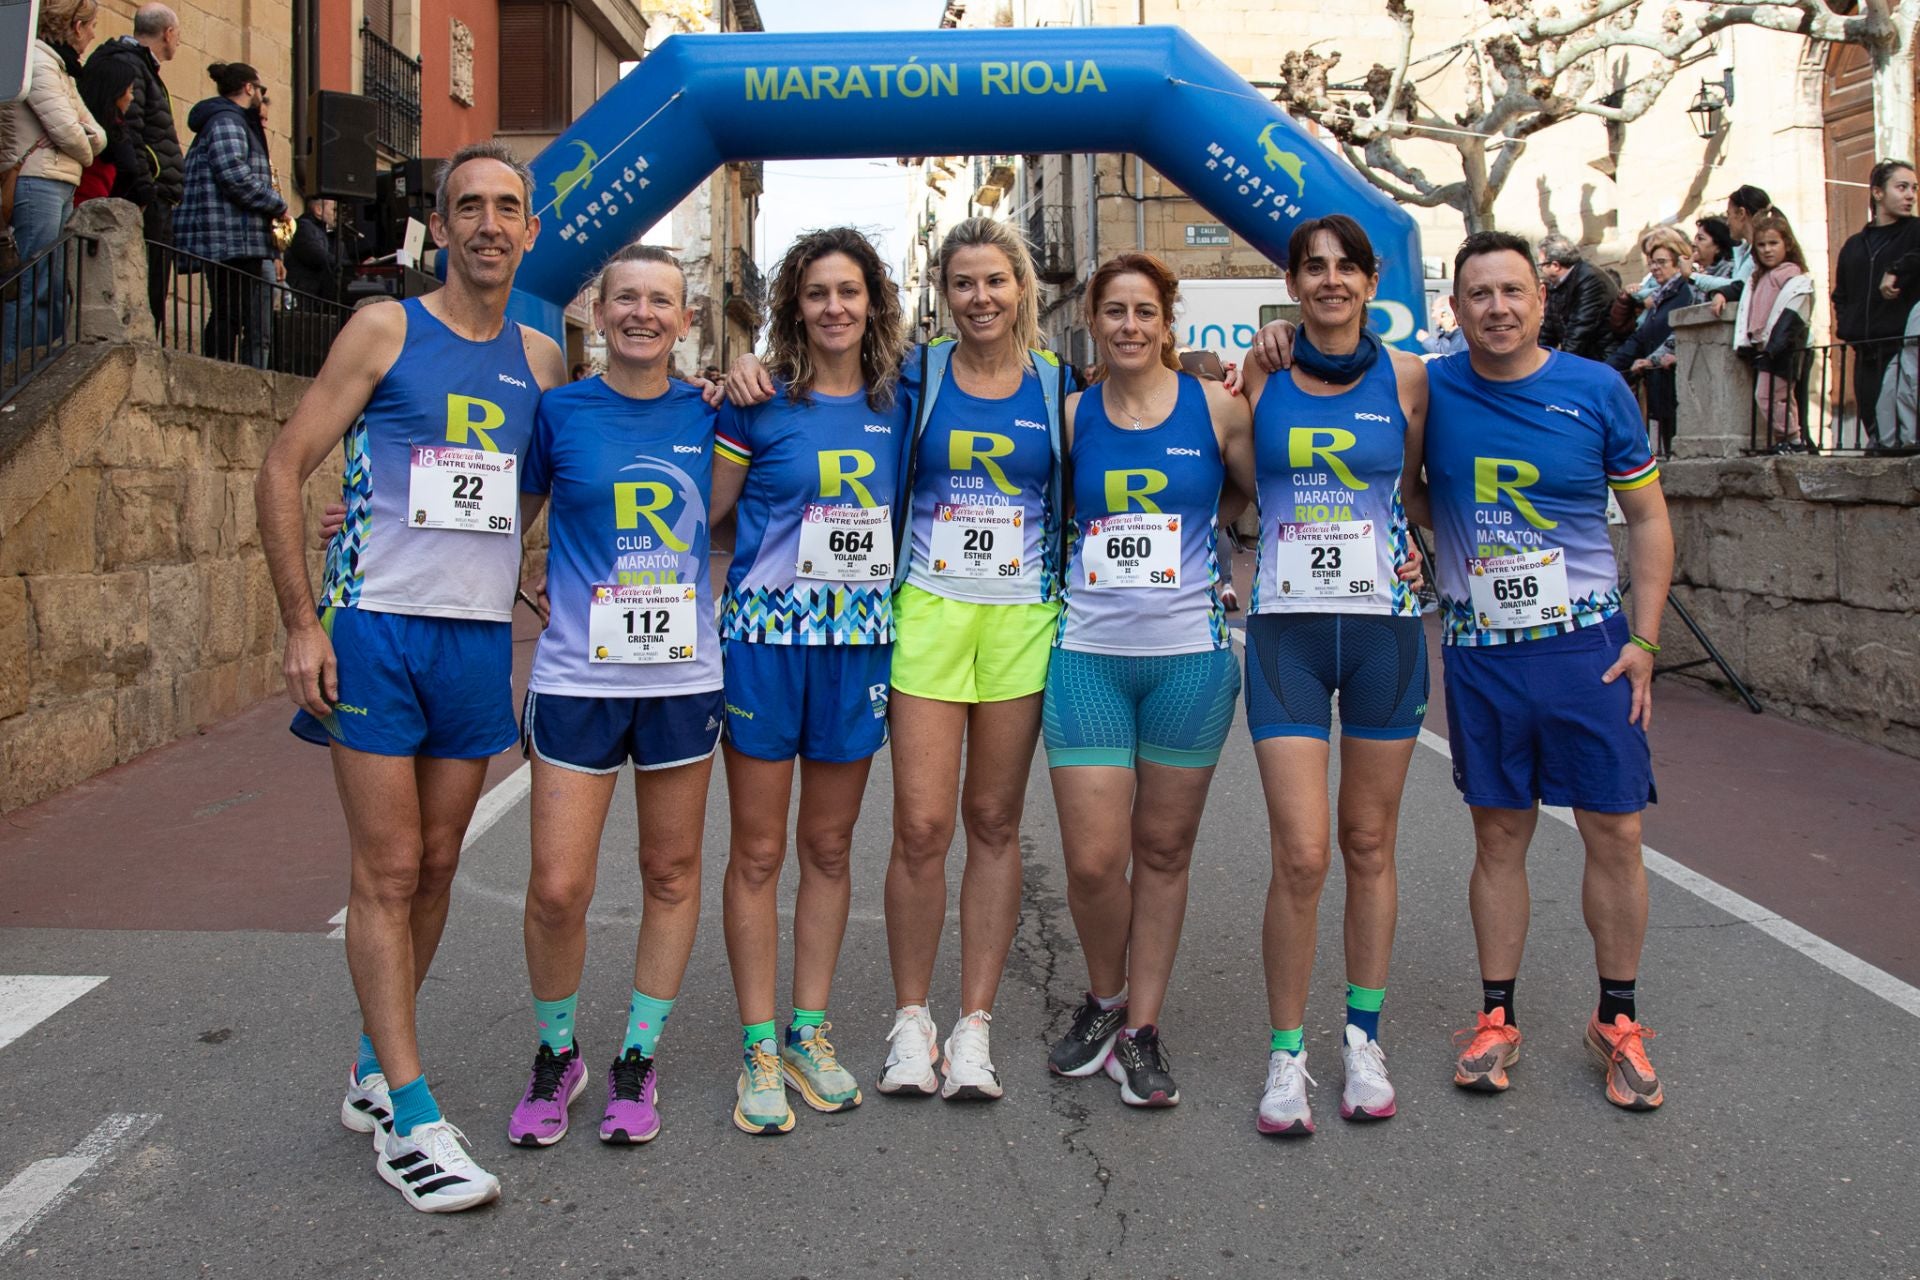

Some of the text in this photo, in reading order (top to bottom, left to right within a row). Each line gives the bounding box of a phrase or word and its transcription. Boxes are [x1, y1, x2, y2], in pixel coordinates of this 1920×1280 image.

[745, 56, 1107, 100] MARATÓN RIOJA
[1207, 142, 1301, 218] MARATÓN
[560, 156, 649, 240] MARATÓN
[1206, 159, 1280, 221] RIOJA
[576, 177, 651, 244] RIOJA
[446, 393, 505, 453] R
[417, 448, 435, 467] 18
[437, 460, 501, 472] ENTRE VIÑEDOS
[949, 430, 1022, 495] R
[1289, 427, 1368, 490] R
[453, 475, 483, 500] 22
[818, 449, 877, 508] R
[950, 476, 984, 489] CLUB
[1293, 473, 1327, 486] CLUB
[950, 492, 1009, 506] MARATÓN
[1104, 468, 1168, 514] R
[1294, 488, 1354, 504] MARATÓN
[1475, 456, 1558, 529] R
[454, 501, 481, 510] MANEL
[809, 505, 824, 523] 18
[1295, 505, 1353, 522] RIOJA
[488, 515, 512, 531] SDi
[614, 481, 689, 552] R
[824, 517, 850, 525] ENTRE
[1475, 510, 1513, 524] CLUB
[1102, 525, 1125, 533] ENTRE
[1284, 525, 1296, 541] 18
[1324, 533, 1359, 541] VIÑEDOS
[1476, 528, 1543, 544] MARATÓN
[617, 536, 652, 550] CLUB
[829, 530, 873, 552] 664
[964, 529, 993, 551] 20
[1107, 536, 1151, 559] 660
[617, 551, 679, 570] MARATÓN
[1117, 559, 1139, 567] NINES
[1311, 547, 1342, 569] 23
[870, 563, 891, 576] SDi
[1312, 570, 1341, 578] ESTHER
[1484, 566, 1509, 574] ENTRE
[1349, 579, 1375, 593] SDi
[1493, 575, 1539, 601] 656
[1499, 598, 1537, 609] JONATHAN
[623, 610, 670, 634] 112
[628, 635, 664, 643] CRISTINA
[869, 683, 888, 701] R
